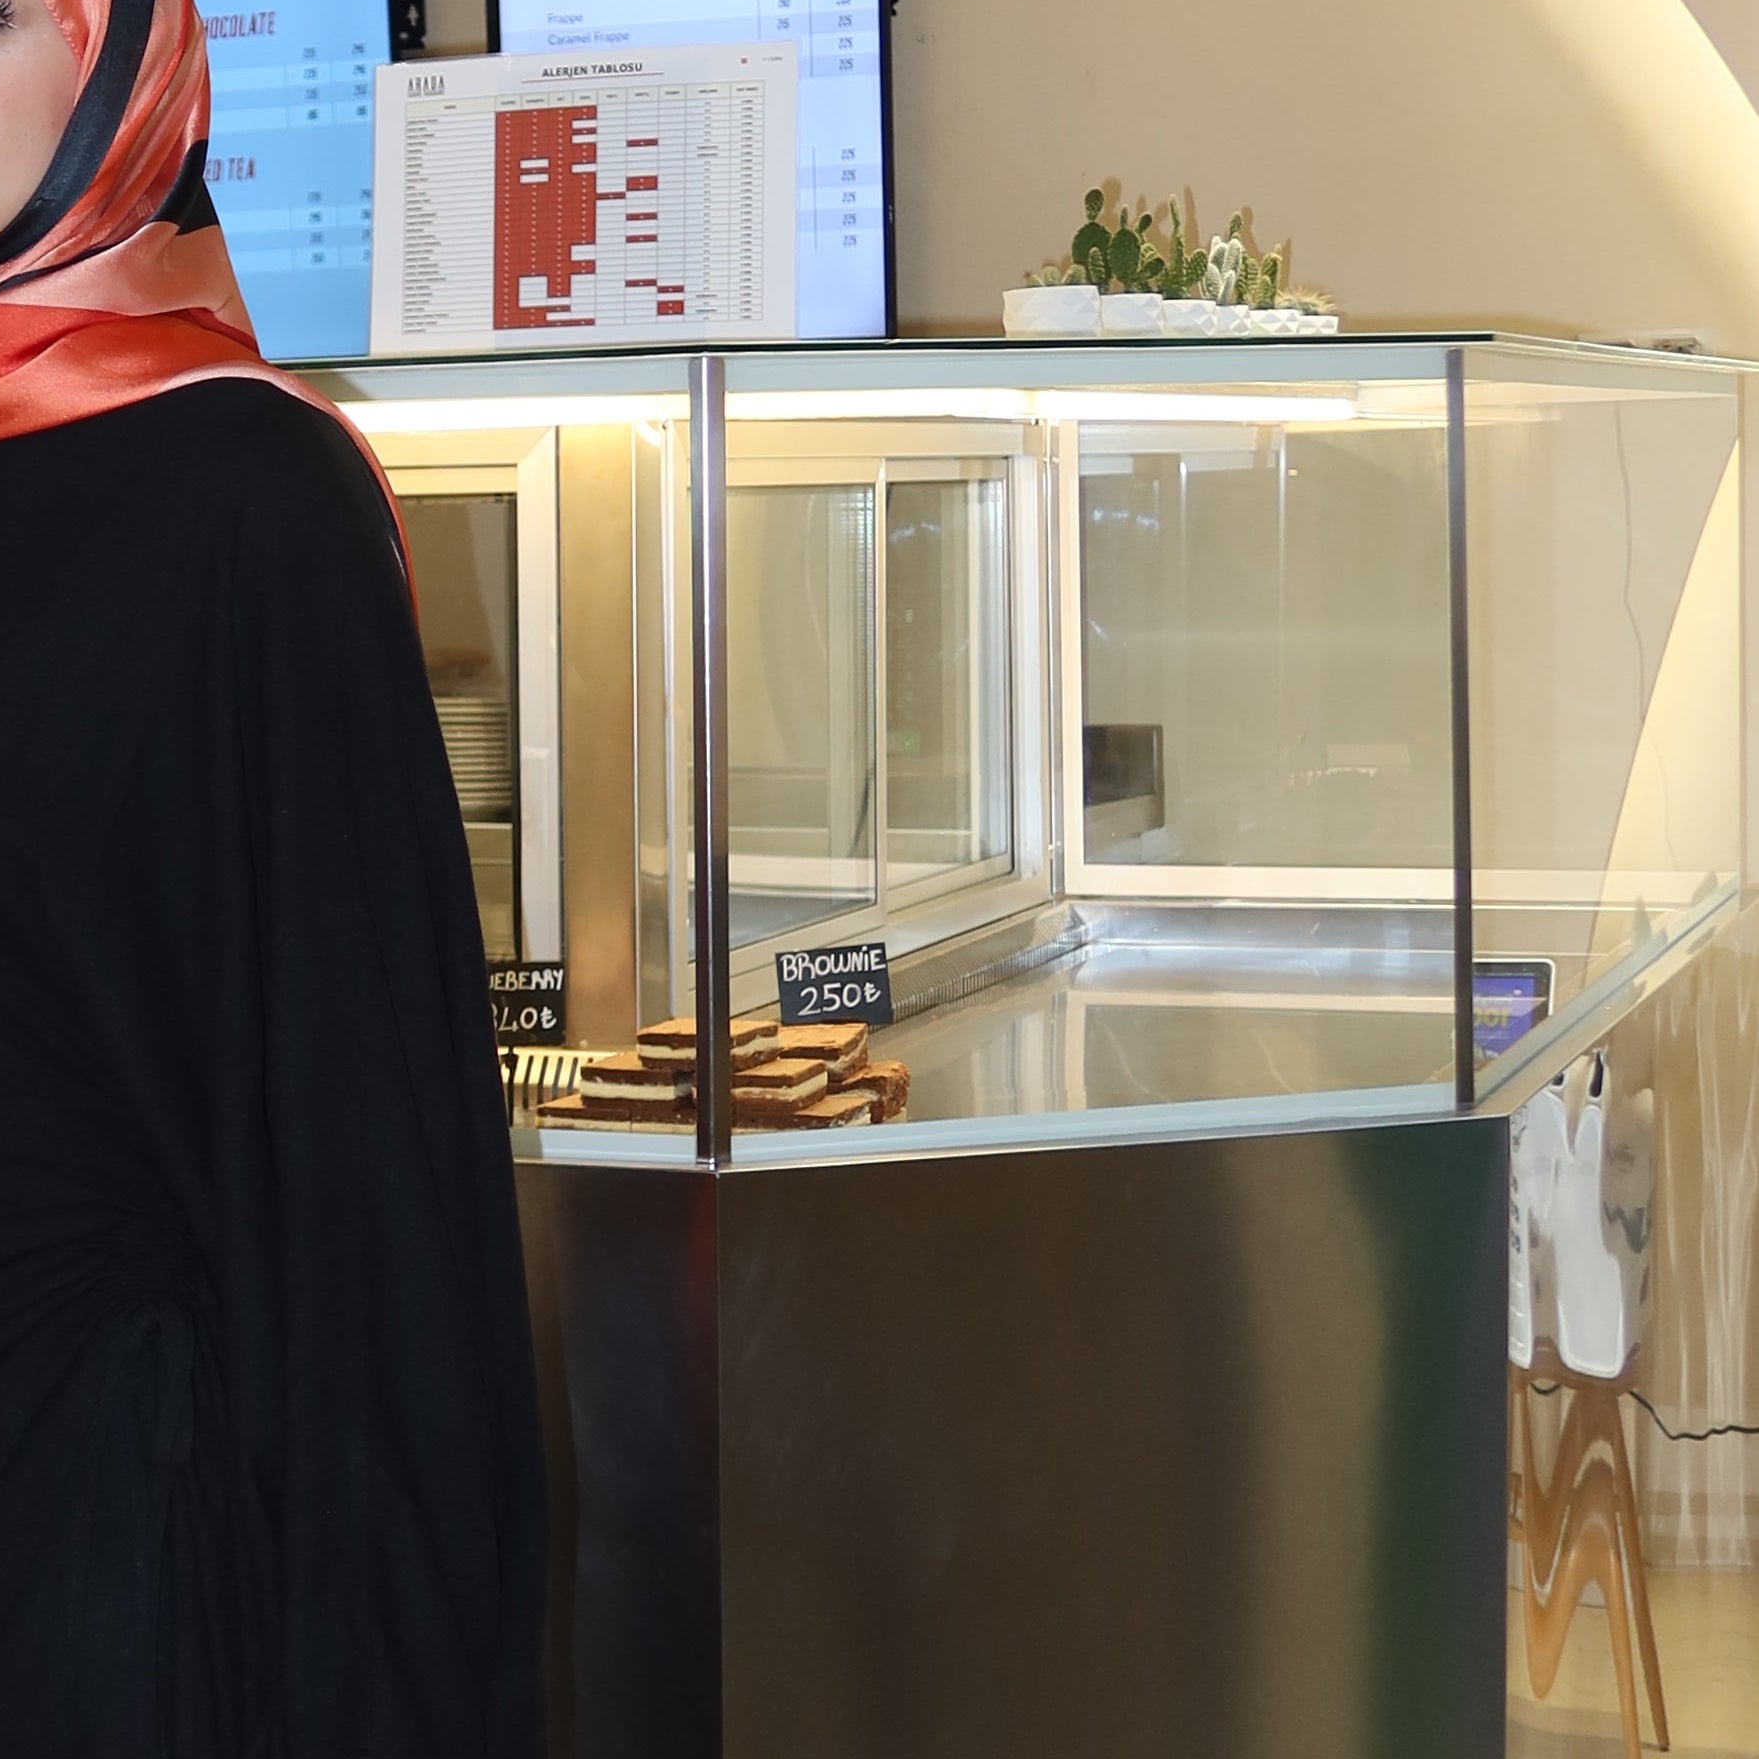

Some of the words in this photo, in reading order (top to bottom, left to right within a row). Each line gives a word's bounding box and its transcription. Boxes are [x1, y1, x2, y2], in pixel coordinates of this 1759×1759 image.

[203, 10, 276, 39] HOCOLATE
[542, 65, 588, 78] ALERJEN
[591, 62, 643, 74] TABLOSU
[228, 156, 256, 181] TEA
[489, 968, 564, 991] EBERRY
